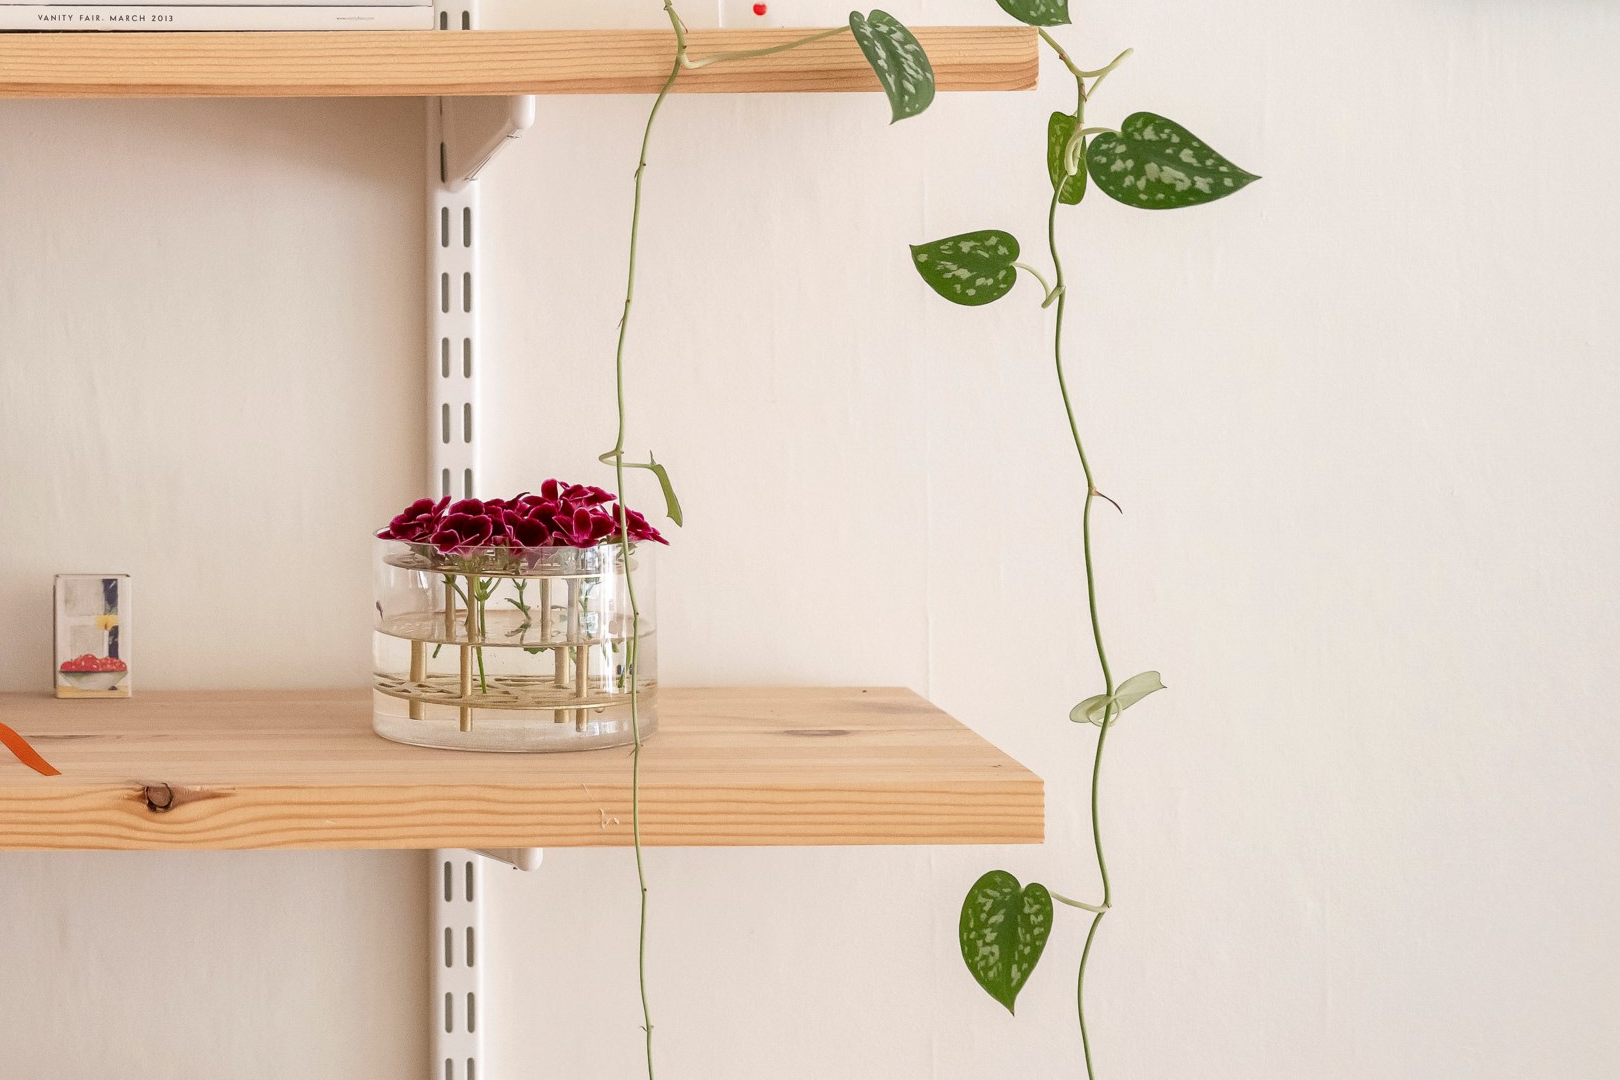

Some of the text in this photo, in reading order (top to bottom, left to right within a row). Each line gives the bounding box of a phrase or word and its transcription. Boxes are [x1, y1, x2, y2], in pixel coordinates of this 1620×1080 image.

[37, 14, 173, 22] VANITY FAIR. MARCH 2013
